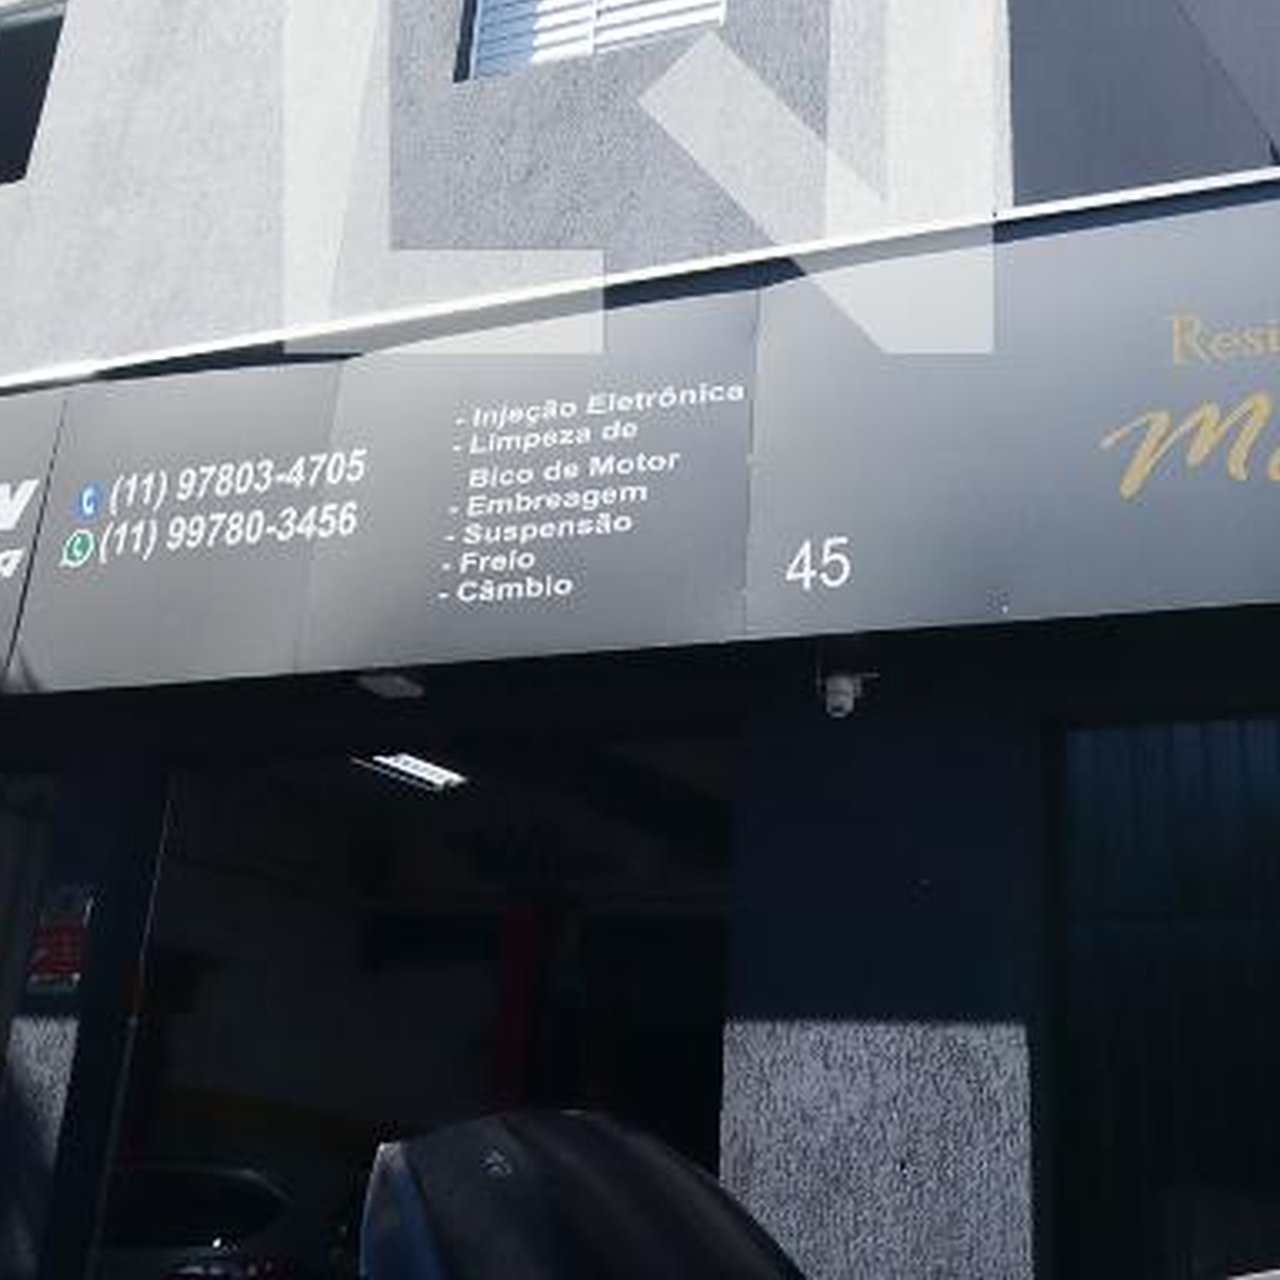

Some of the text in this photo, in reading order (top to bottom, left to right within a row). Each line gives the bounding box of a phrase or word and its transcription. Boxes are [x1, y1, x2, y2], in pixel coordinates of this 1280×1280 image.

[472, 399, 577, 430] Injeção
[586, 382, 745, 414] Eletrônica
[469, 426, 591, 454] Limpeza
[602, 421, 638, 440] de
[110, 449, 368, 516] (11) 97803-4705
[469, 452, 681, 488] Bico de Motor
[467, 485, 648, 517] Embreagem
[99, 501, 358, 564] (11) 99780-3456
[462, 513, 633, 545] Suspensão
[459, 549, 536, 574] Freio
[786, 537, 851, 590] 45
[457, 575, 573, 602] Câmbio
